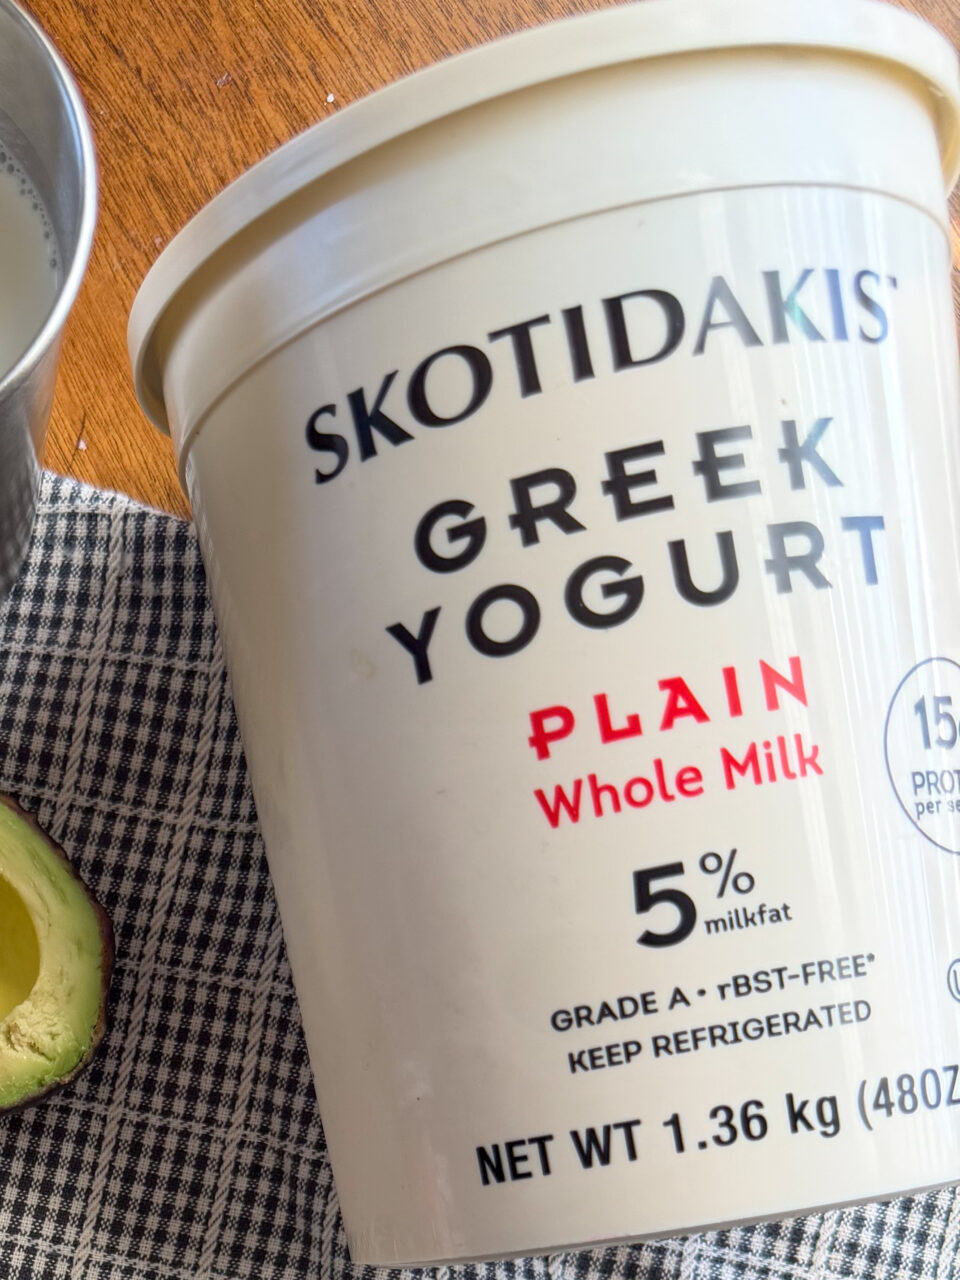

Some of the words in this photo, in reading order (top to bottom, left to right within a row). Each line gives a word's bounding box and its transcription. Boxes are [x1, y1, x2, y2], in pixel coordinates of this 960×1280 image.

[305, 268, 888, 484] SKOTIDAKIS
[414, 417, 844, 573] GREEK
[386, 515, 886, 685] YOGURT
[527, 656, 808, 761] PLAIN
[914, 694, 960, 750] 15
[534, 759, 704, 829] Whole
[719, 734, 824, 790] Milk
[915, 800, 941, 820] per
[704, 902, 792, 936] milkfat
[550, 991, 658, 1032] GRADE
[669, 986, 690, 1010] A
[568, 1040, 642, 1074] KEEP
[652, 1000, 872, 1059] REFRIGERATED
[476, 1135, 553, 1186] NET
[571, 1119, 641, 1169] WT
[662, 1100, 768, 1154] 1.36
[785, 1093, 841, 1138] kg
